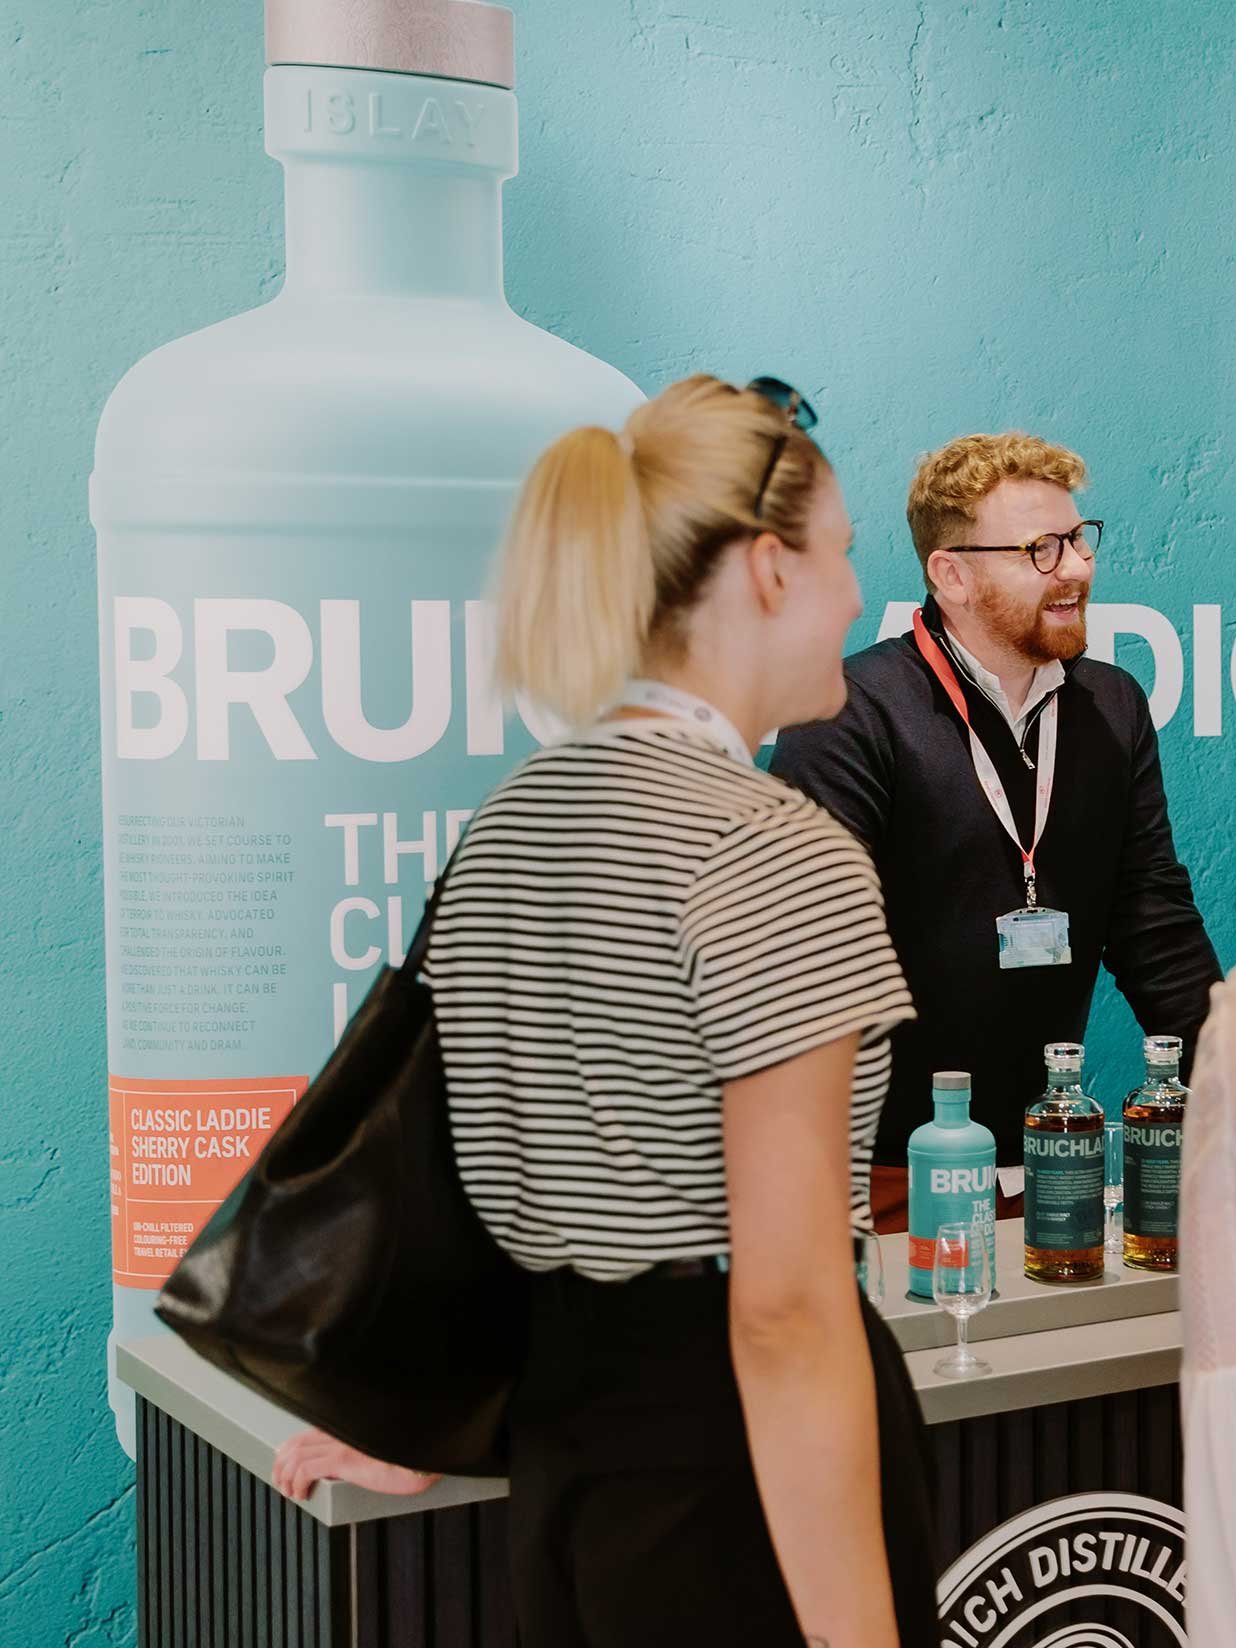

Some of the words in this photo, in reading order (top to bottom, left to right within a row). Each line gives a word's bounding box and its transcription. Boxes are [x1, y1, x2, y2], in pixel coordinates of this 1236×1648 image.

[303, 88, 486, 148] ISLAY
[227, 834, 273, 847] COURSE
[276, 834, 293, 847] TO
[199, 852, 236, 865] AIMING
[239, 852, 255, 865] TO
[256, 852, 292, 865] MAKE
[256, 871, 296, 884] SPIRIT
[226, 890, 248, 902] THE
[250, 890, 279, 902] IDEA
[208, 908, 276, 921] ADVOCATED
[229, 927, 254, 939] AND
[200, 964, 242, 977] WHISKY
[244, 964, 270, 977] CAN
[272, 964, 287, 977] BE
[223, 983, 235, 995] IT
[236, 983, 260, 995] CAN
[262, 983, 278, 995] BE
[192, 1020, 256, 1033] RECONNECT
[131, 1108, 192, 1131] CLASSIC
[196, 1107, 272, 1131] LADDIE
[131, 1135, 191, 1159] SHERRY
[193, 1135, 250, 1158] CASK
[132, 1163, 192, 1186] EDITION
[972, 1198, 992, 1213] THE
[161, 1222, 194, 1233] FILTERED
